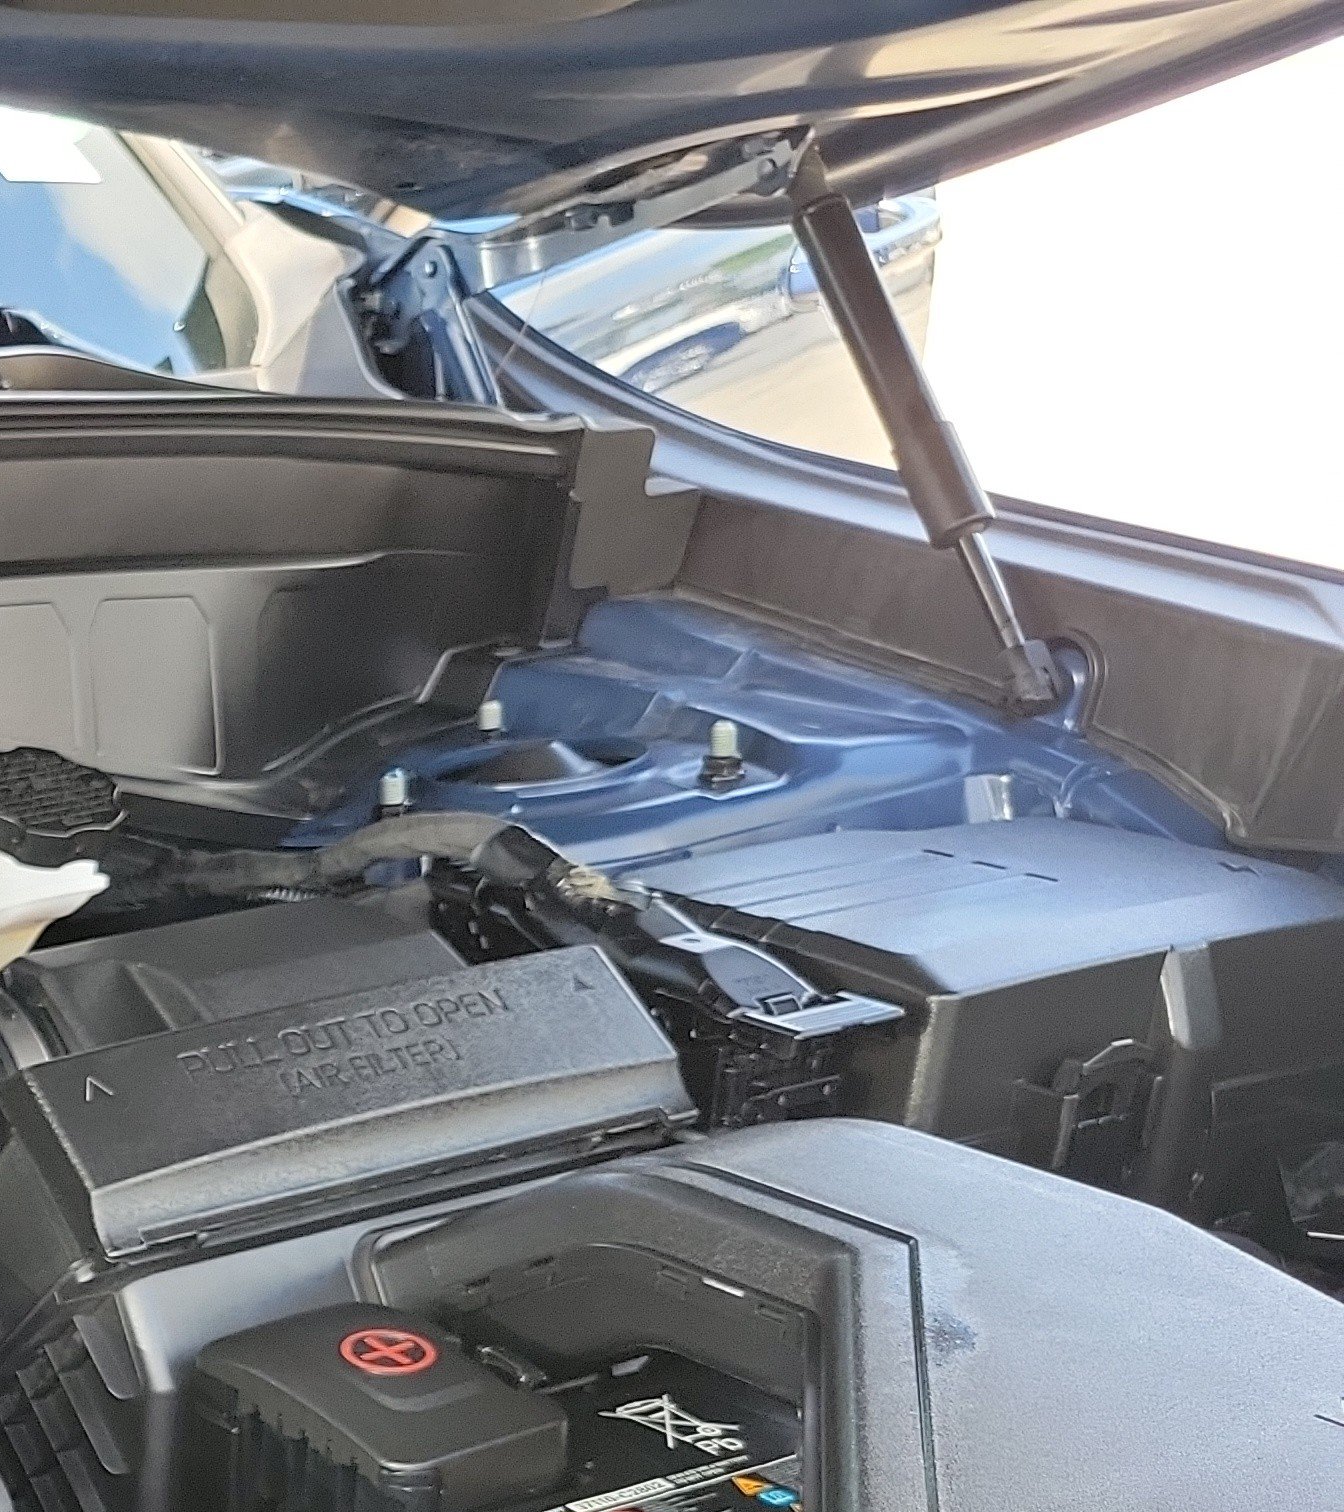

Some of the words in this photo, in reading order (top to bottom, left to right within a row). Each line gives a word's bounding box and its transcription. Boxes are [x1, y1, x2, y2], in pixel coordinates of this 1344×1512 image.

[176, 1038, 282, 1081] PULL
[277, 1016, 355, 1055] OUT
[353, 1007, 411, 1038] TO
[413, 987, 510, 1029] OPEN
